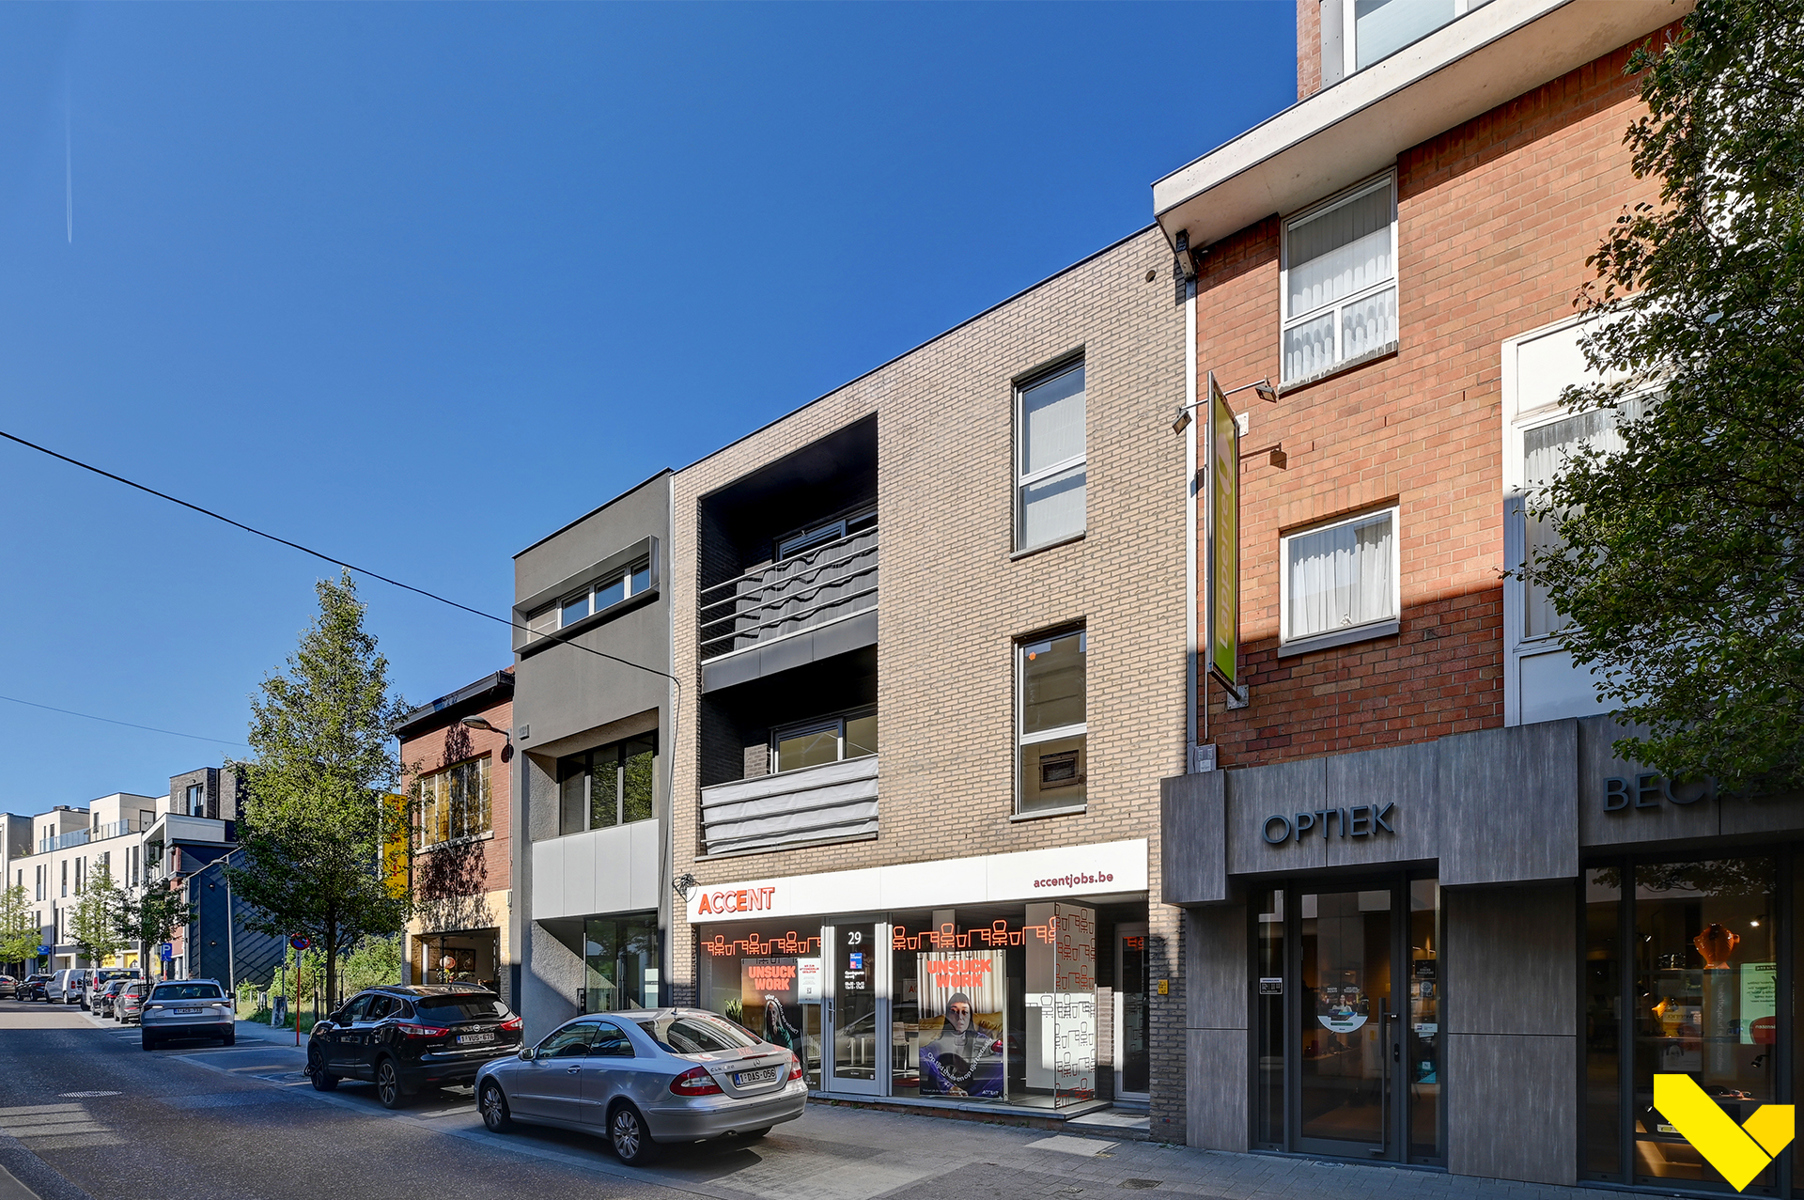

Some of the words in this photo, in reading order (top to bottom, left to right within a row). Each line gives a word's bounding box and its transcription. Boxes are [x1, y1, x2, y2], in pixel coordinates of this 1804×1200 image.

[1219, 493, 1231, 650] Lapperre
[1262, 802, 1394, 844] OPTIEK
[1033, 871, 1114, 889] accentjobs.be
[698, 886, 775, 914] ACCENT
[847, 931, 862, 945] 29
[162, 944, 171, 955] P
[748, 965, 796, 978] UNSUCK
[926, 958, 992, 975] UNSUCK
[754, 978, 790, 991] WORK
[935, 973, 983, 988] WORK
[927, 1051, 936, 1063] Op
[935, 1060, 944, 1072] tijd
[942, 1067, 957, 1082] thuis
